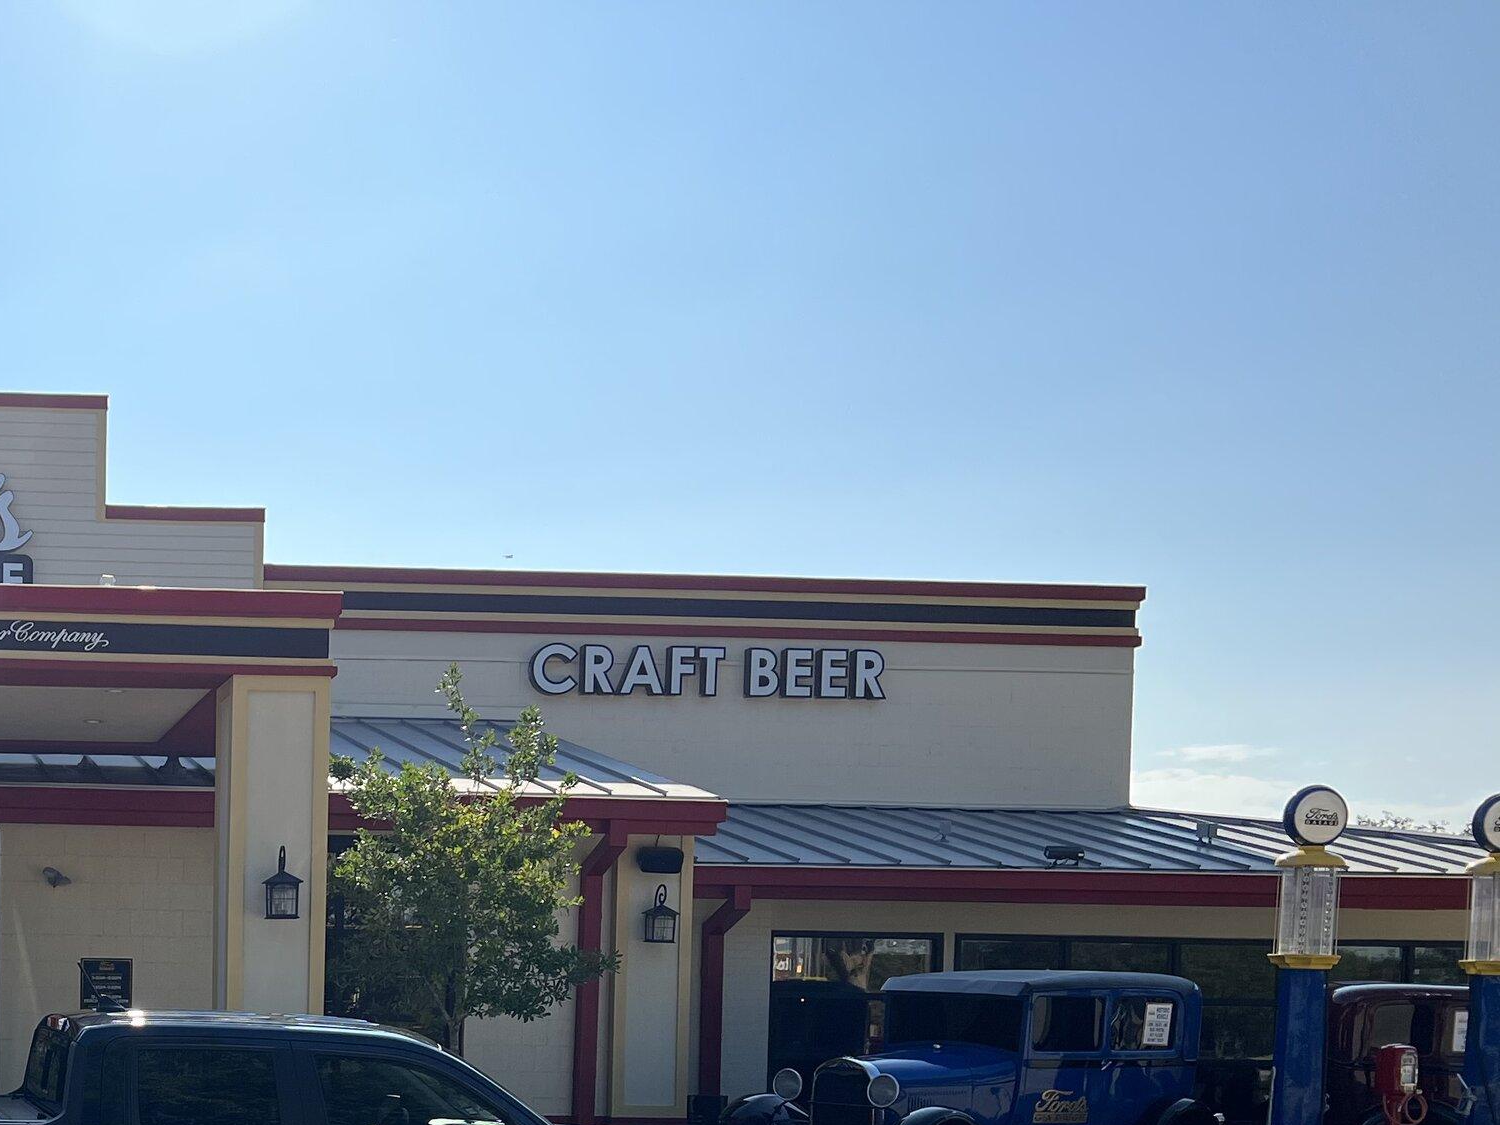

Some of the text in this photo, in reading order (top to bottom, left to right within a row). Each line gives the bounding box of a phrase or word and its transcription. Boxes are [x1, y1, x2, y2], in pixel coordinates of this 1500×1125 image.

[10, 620, 109, 650] Company
[528, 642, 886, 699] CRAFT BEER
